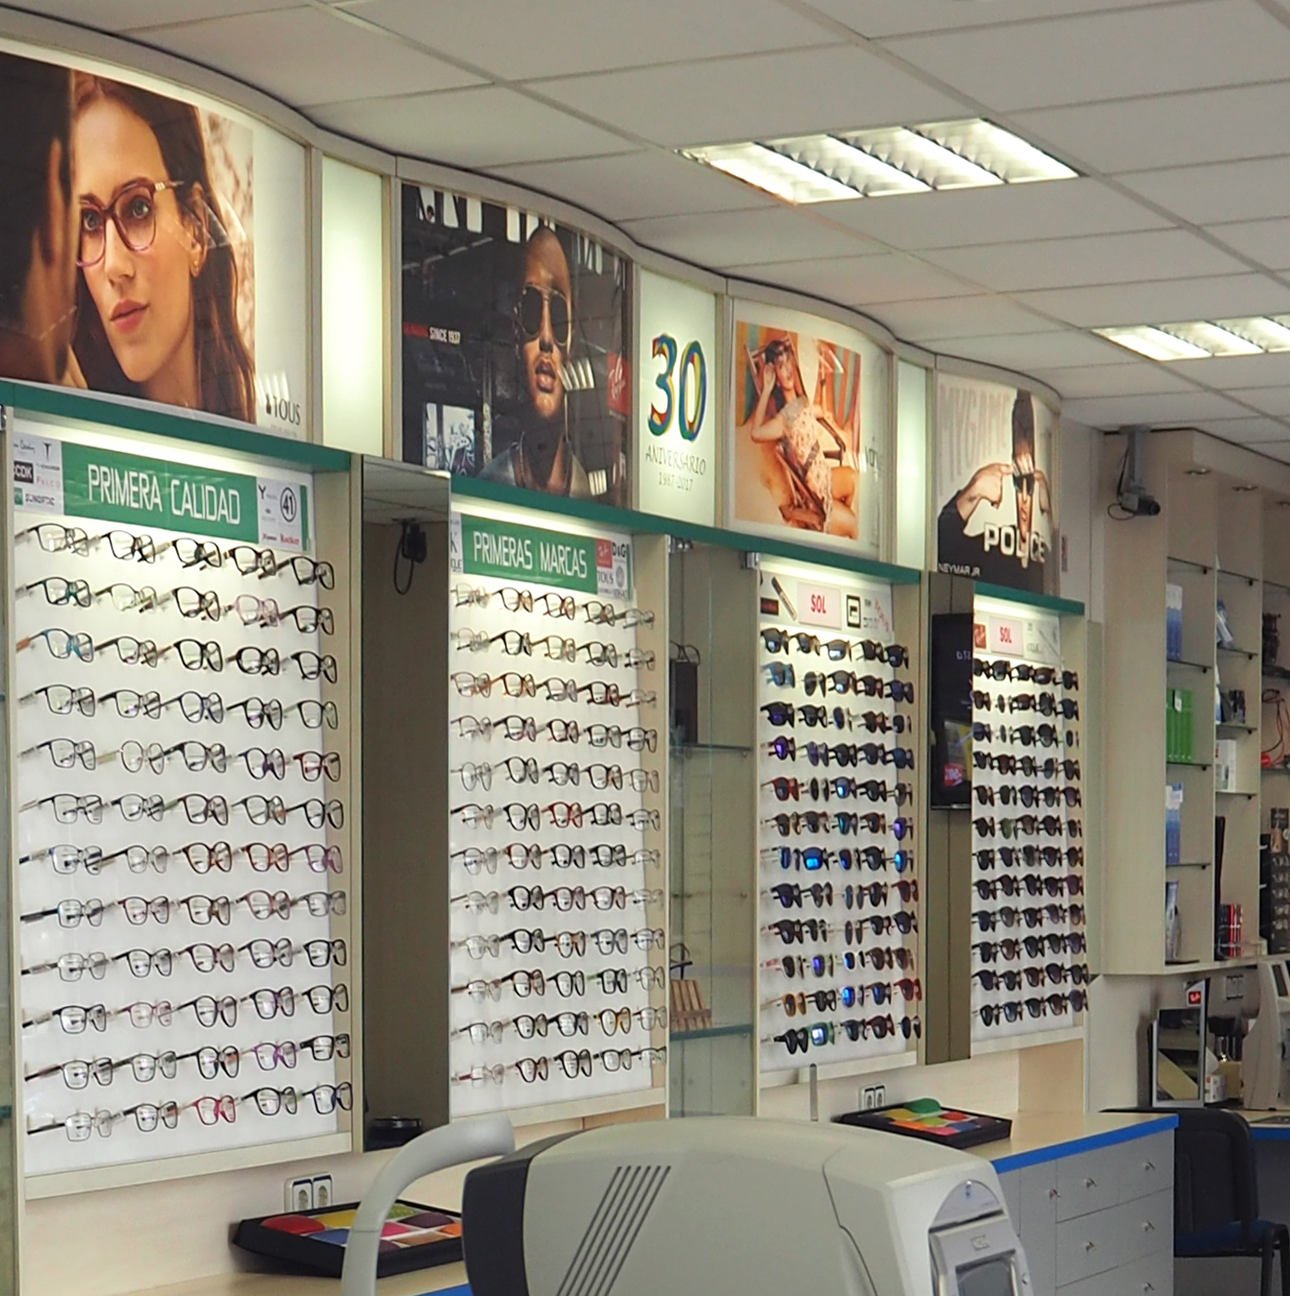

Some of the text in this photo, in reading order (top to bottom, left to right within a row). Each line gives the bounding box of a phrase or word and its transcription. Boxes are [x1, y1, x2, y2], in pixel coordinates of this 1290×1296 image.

[648, 332, 707, 442] 30
[273, 395, 301, 426] TOUS
[645, 444, 707, 476] ANIVERSARIO
[87, 463, 241, 525] PRIMERA CALIDAD
[473, 531, 588, 579] PRIMERAS MARCAS
[984, 522, 1046, 568] POLICE
[810, 594, 826, 614] SOL
[999, 626, 1012, 644] SOL
